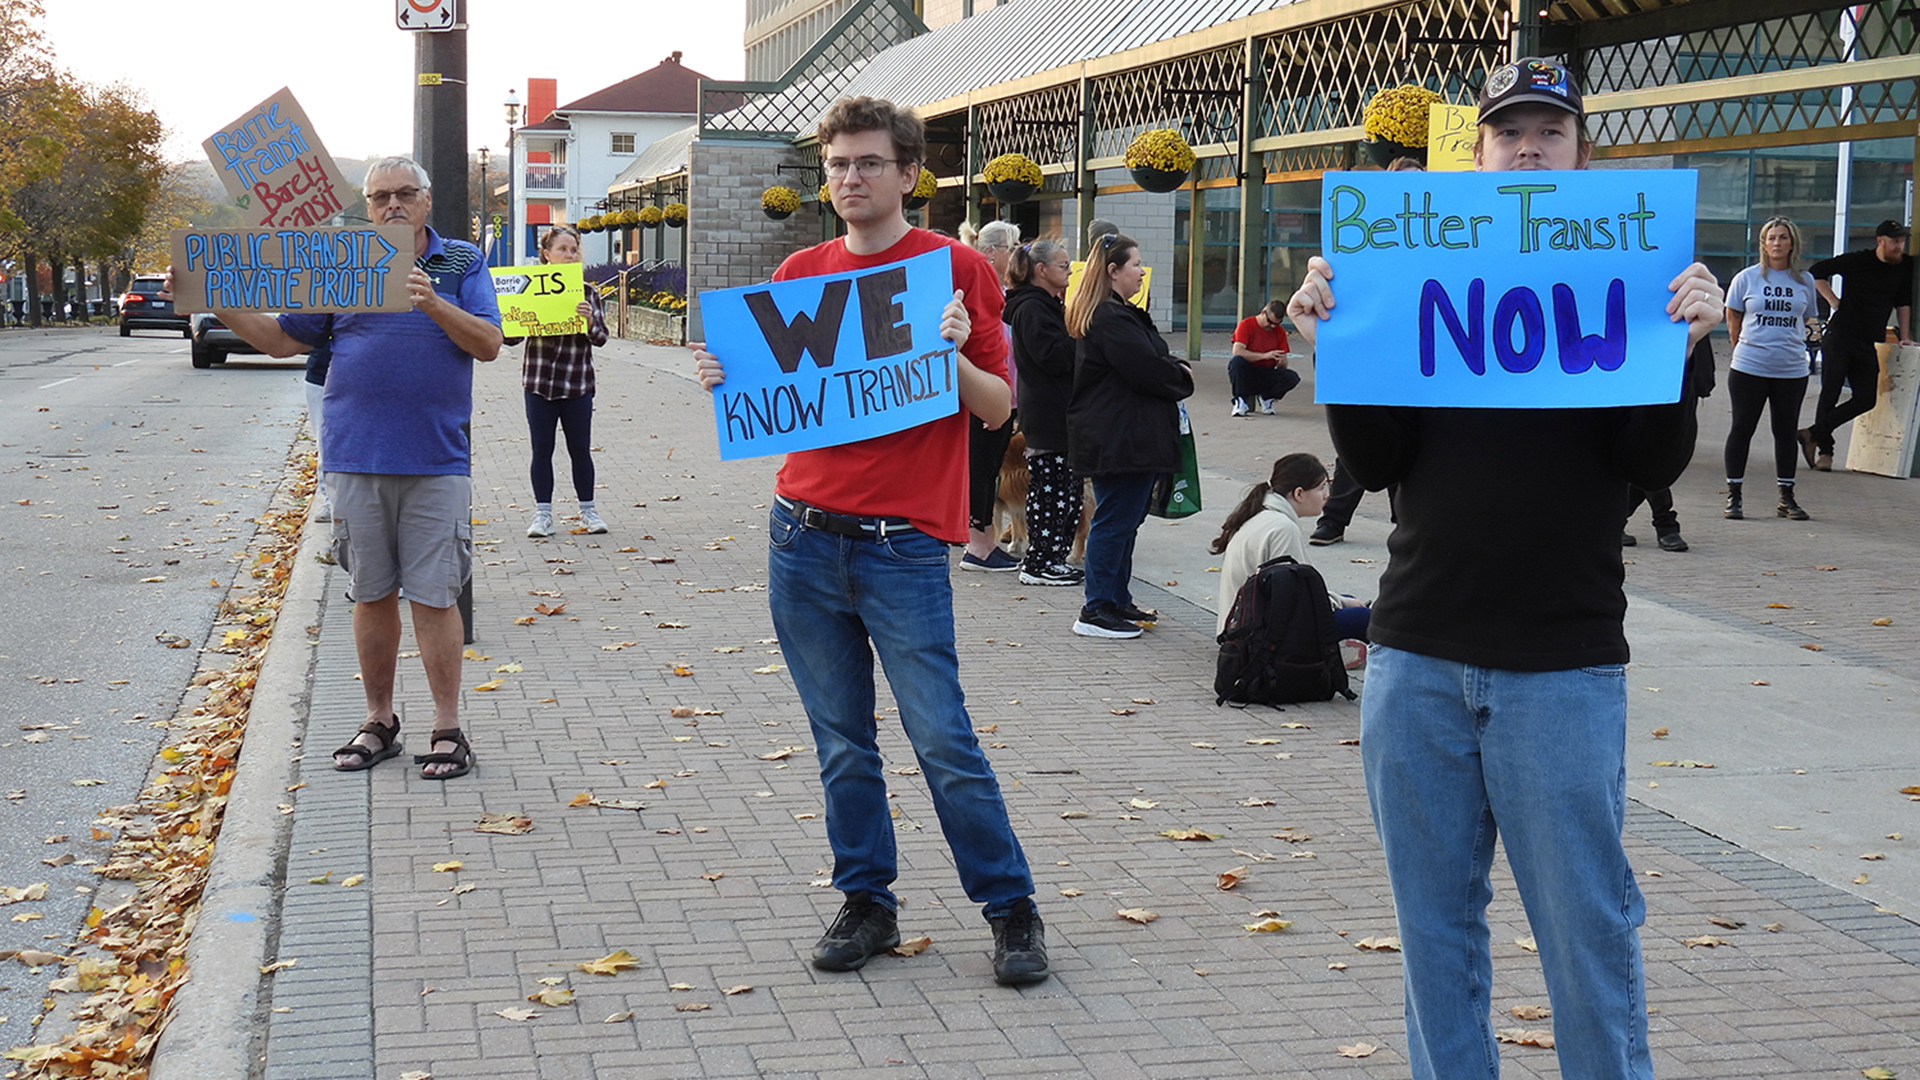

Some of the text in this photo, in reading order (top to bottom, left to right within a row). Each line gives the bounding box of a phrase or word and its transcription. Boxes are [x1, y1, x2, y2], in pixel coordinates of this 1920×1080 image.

[212, 102, 290, 163] Barrie
[225, 121, 310, 190] Transit
[253, 155, 328, 214] Barely
[1328, 183, 1659, 254] Better Transit
[185, 232, 272, 271] PUBLIC
[205, 266, 390, 308] PRIVATE PROFIT
[495, 276, 521, 286] Barrie
[1763, 286, 1794, 298] C.O.B
[1764, 299, 1792, 312] kills
[519, 315, 584, 336] Transit
[743, 266, 914, 374] WE
[1418, 278, 1627, 377] NOW
[1755, 314, 1798, 329] Transit
[722, 347, 955, 443] KNOW TRANSIT
